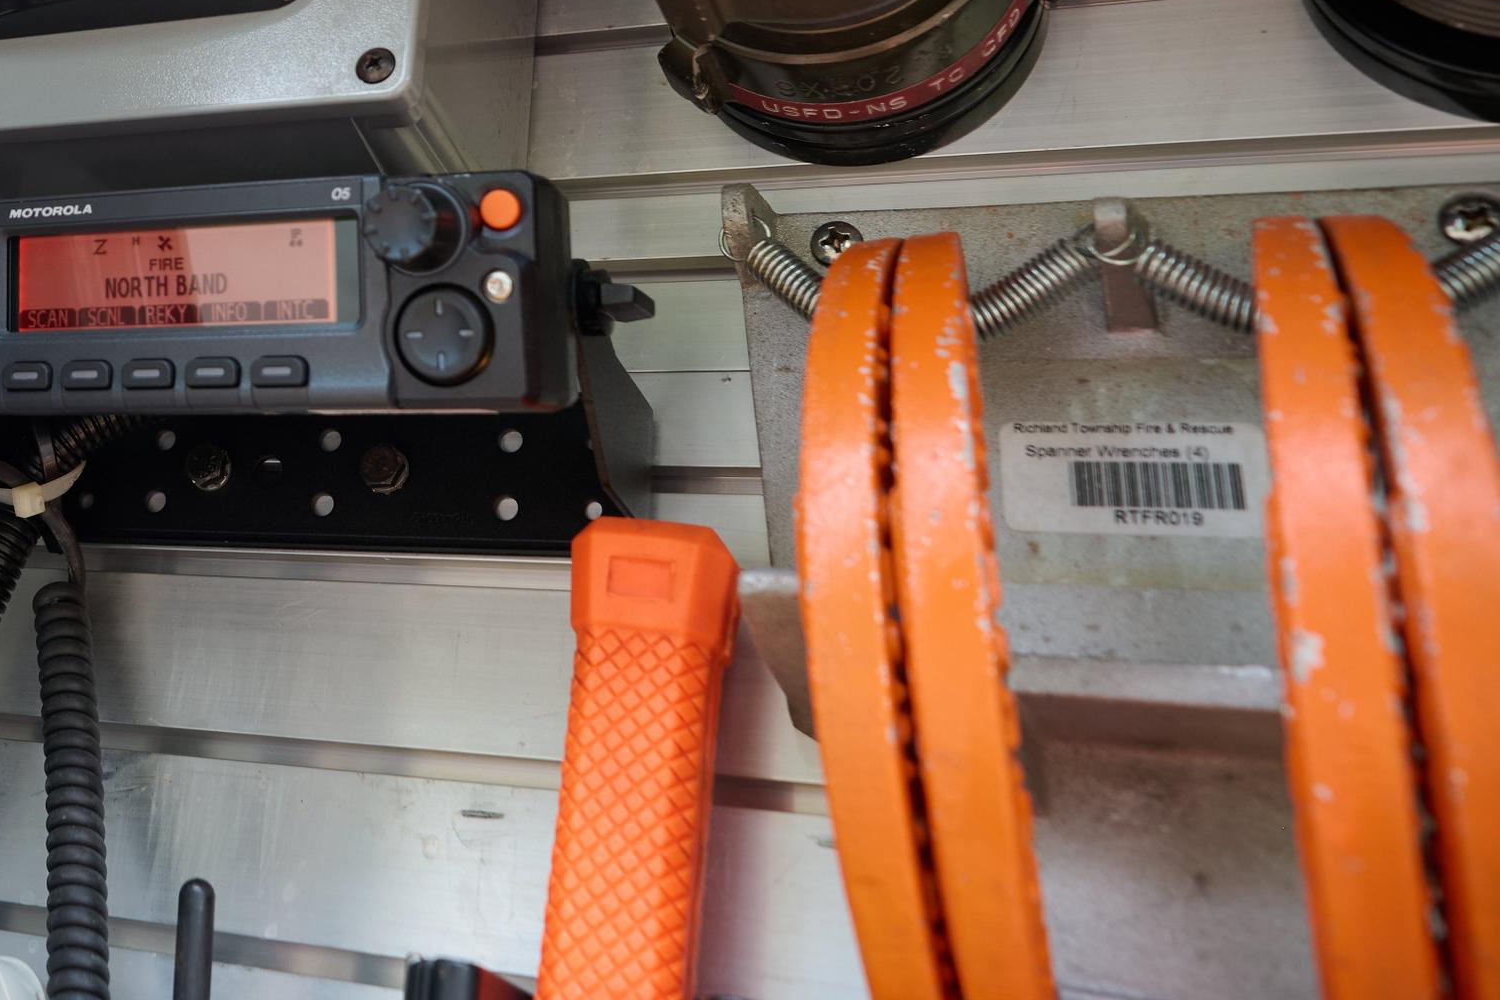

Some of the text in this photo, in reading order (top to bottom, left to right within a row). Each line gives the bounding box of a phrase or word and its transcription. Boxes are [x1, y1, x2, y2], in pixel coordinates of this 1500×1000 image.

[762, 96, 908, 119] USFD-NS
[928, 67, 964, 90] TO
[9, 204, 93, 219] MOTOROLA
[149, 257, 185, 272] FIRE
[105, 273, 228, 299] NORTH BAND
[27, 301, 315, 328] SCAN SCNL REKY INFO INTC
[1137, 423, 1161, 434] Fire
[1166, 424, 1175, 434] &
[1025, 445, 1091, 460] Spanner
[1097, 445, 1179, 458] Wrenches
